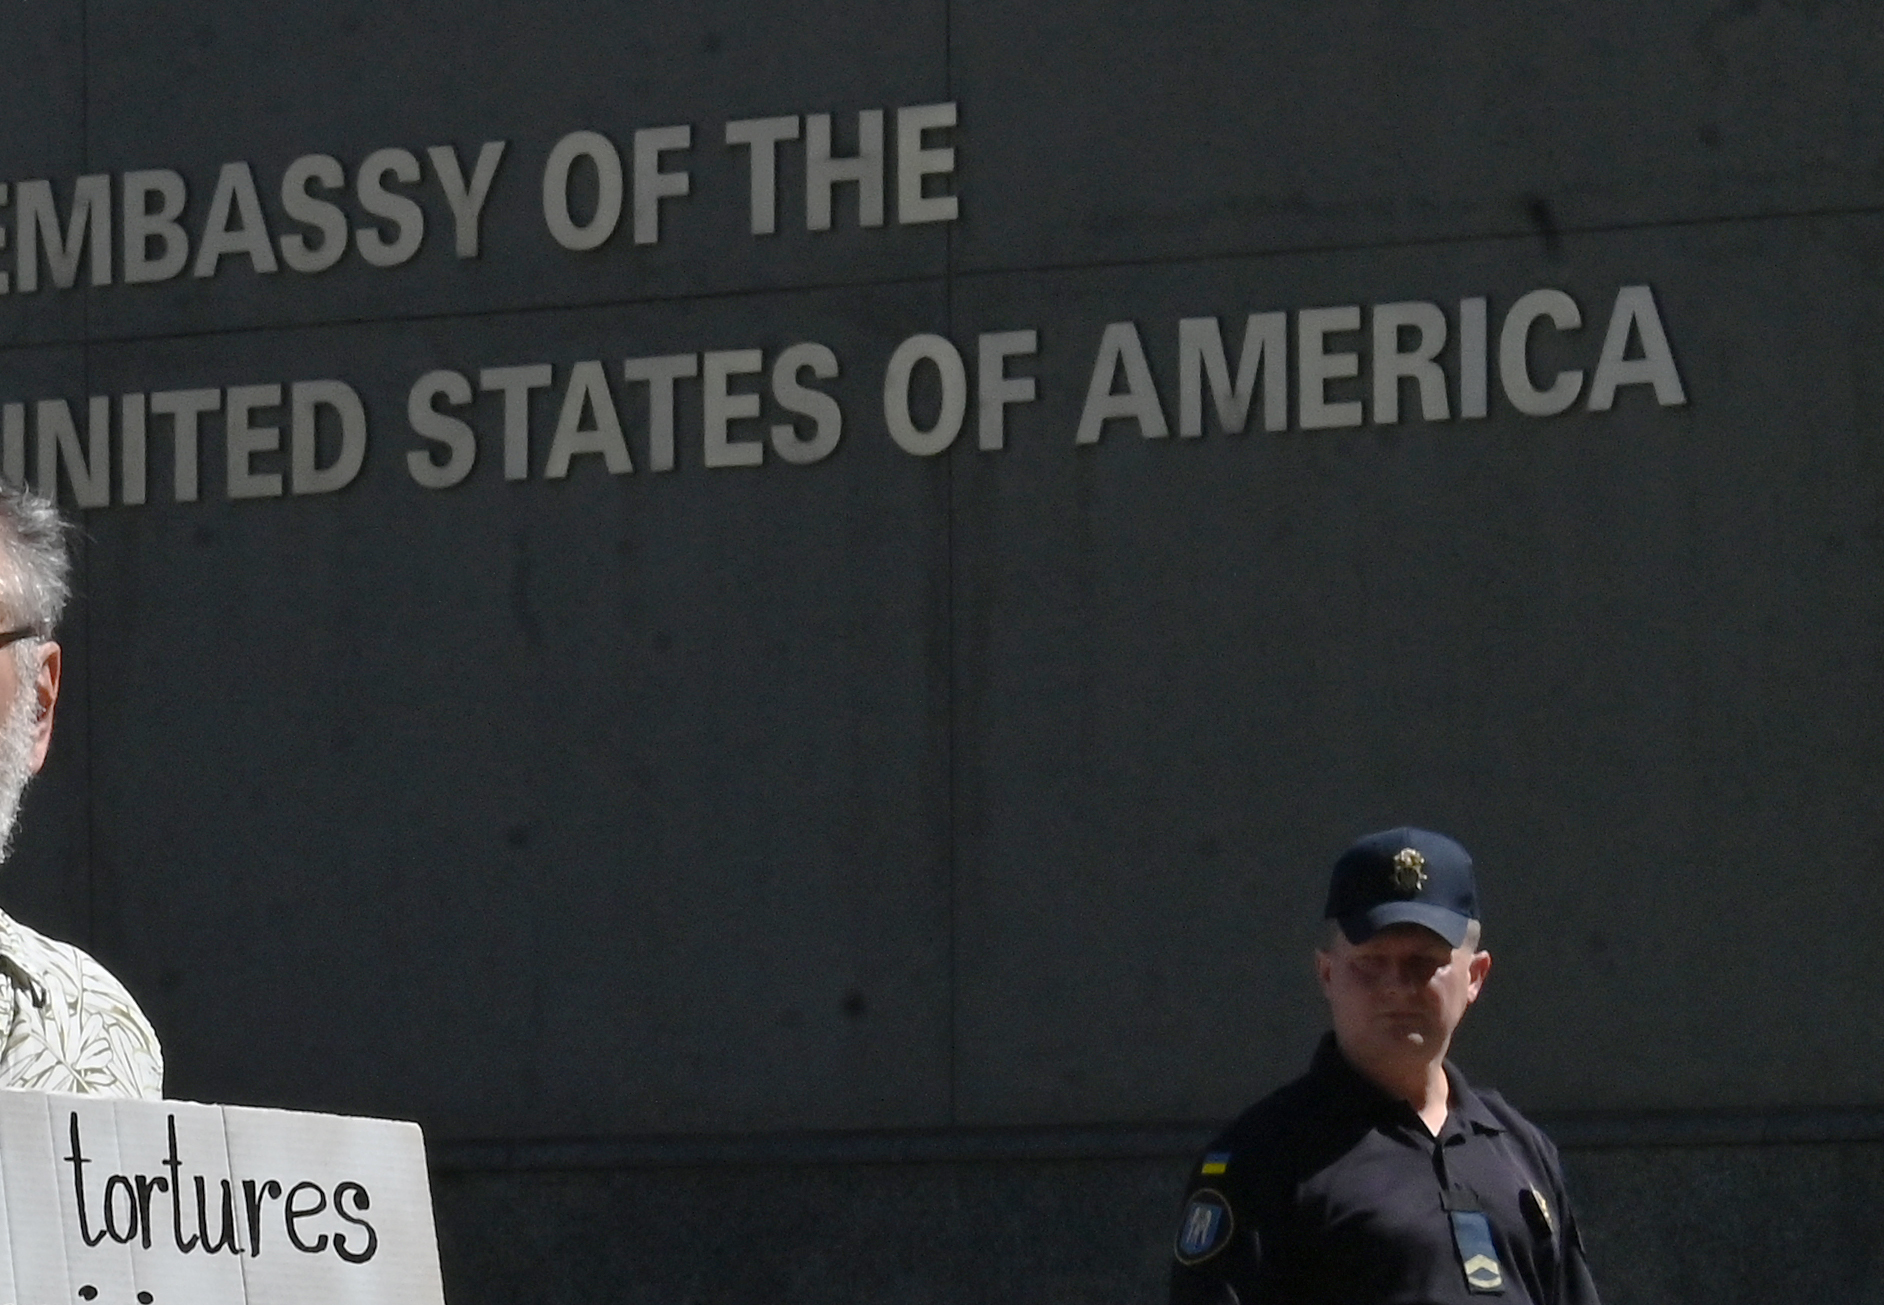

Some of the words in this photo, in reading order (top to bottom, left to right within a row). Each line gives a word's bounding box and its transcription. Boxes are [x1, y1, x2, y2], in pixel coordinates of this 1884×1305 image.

[542, 126, 690, 249] OF
[725, 103, 958, 232] THE
[406, 343, 841, 486] STATES
[883, 331, 1036, 456] OF
[1077, 286, 1685, 443] AMERICA
[64, 1112, 378, 1265] tortures
